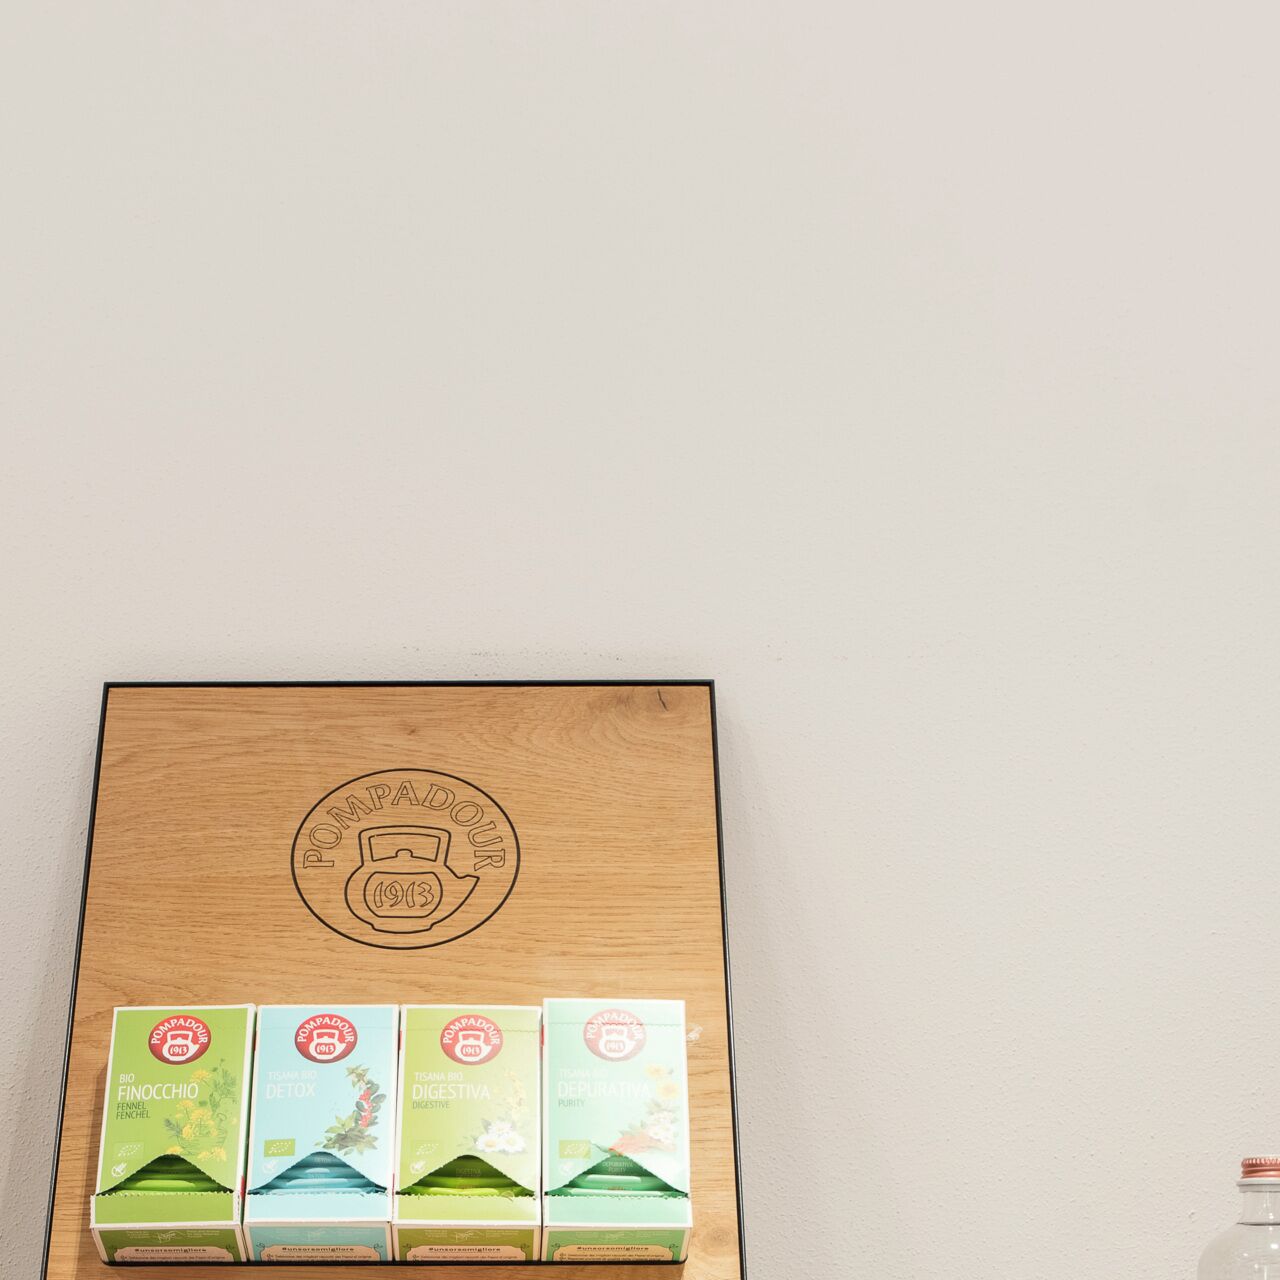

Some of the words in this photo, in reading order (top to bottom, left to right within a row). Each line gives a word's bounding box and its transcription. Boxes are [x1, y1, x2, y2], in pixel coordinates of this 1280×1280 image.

[303, 780, 505, 871] POMPADOUR
[373, 880, 435, 909] 1913
[150, 1018, 208, 1044] POMPADOUR
[297, 1016, 355, 1043] POMPADOUR
[442, 1017, 500, 1045] POMPADOUR
[587, 1012, 645, 1040] POMPADOUR
[169, 1045, 188, 1055] 1913
[316, 1044, 334, 1054] 1913
[462, 1045, 480, 1055] 1913
[120, 1073, 135, 1083] BIO
[415, 1072, 446, 1081] TISANA
[448, 1071, 463, 1081] BIO
[118, 1083, 199, 1101] FINOCCHIO
[266, 1083, 317, 1099] DETOX
[412, 1083, 490, 1100] DIGESTIVA
[557, 1081, 651, 1098] DEPURATIVA
[116, 1102, 147, 1111] FENNEL
[412, 1101, 450, 1110] DIGESTIVE
[558, 1099, 585, 1108] PURITY
[116, 1110, 151, 1120] FENCHEL
